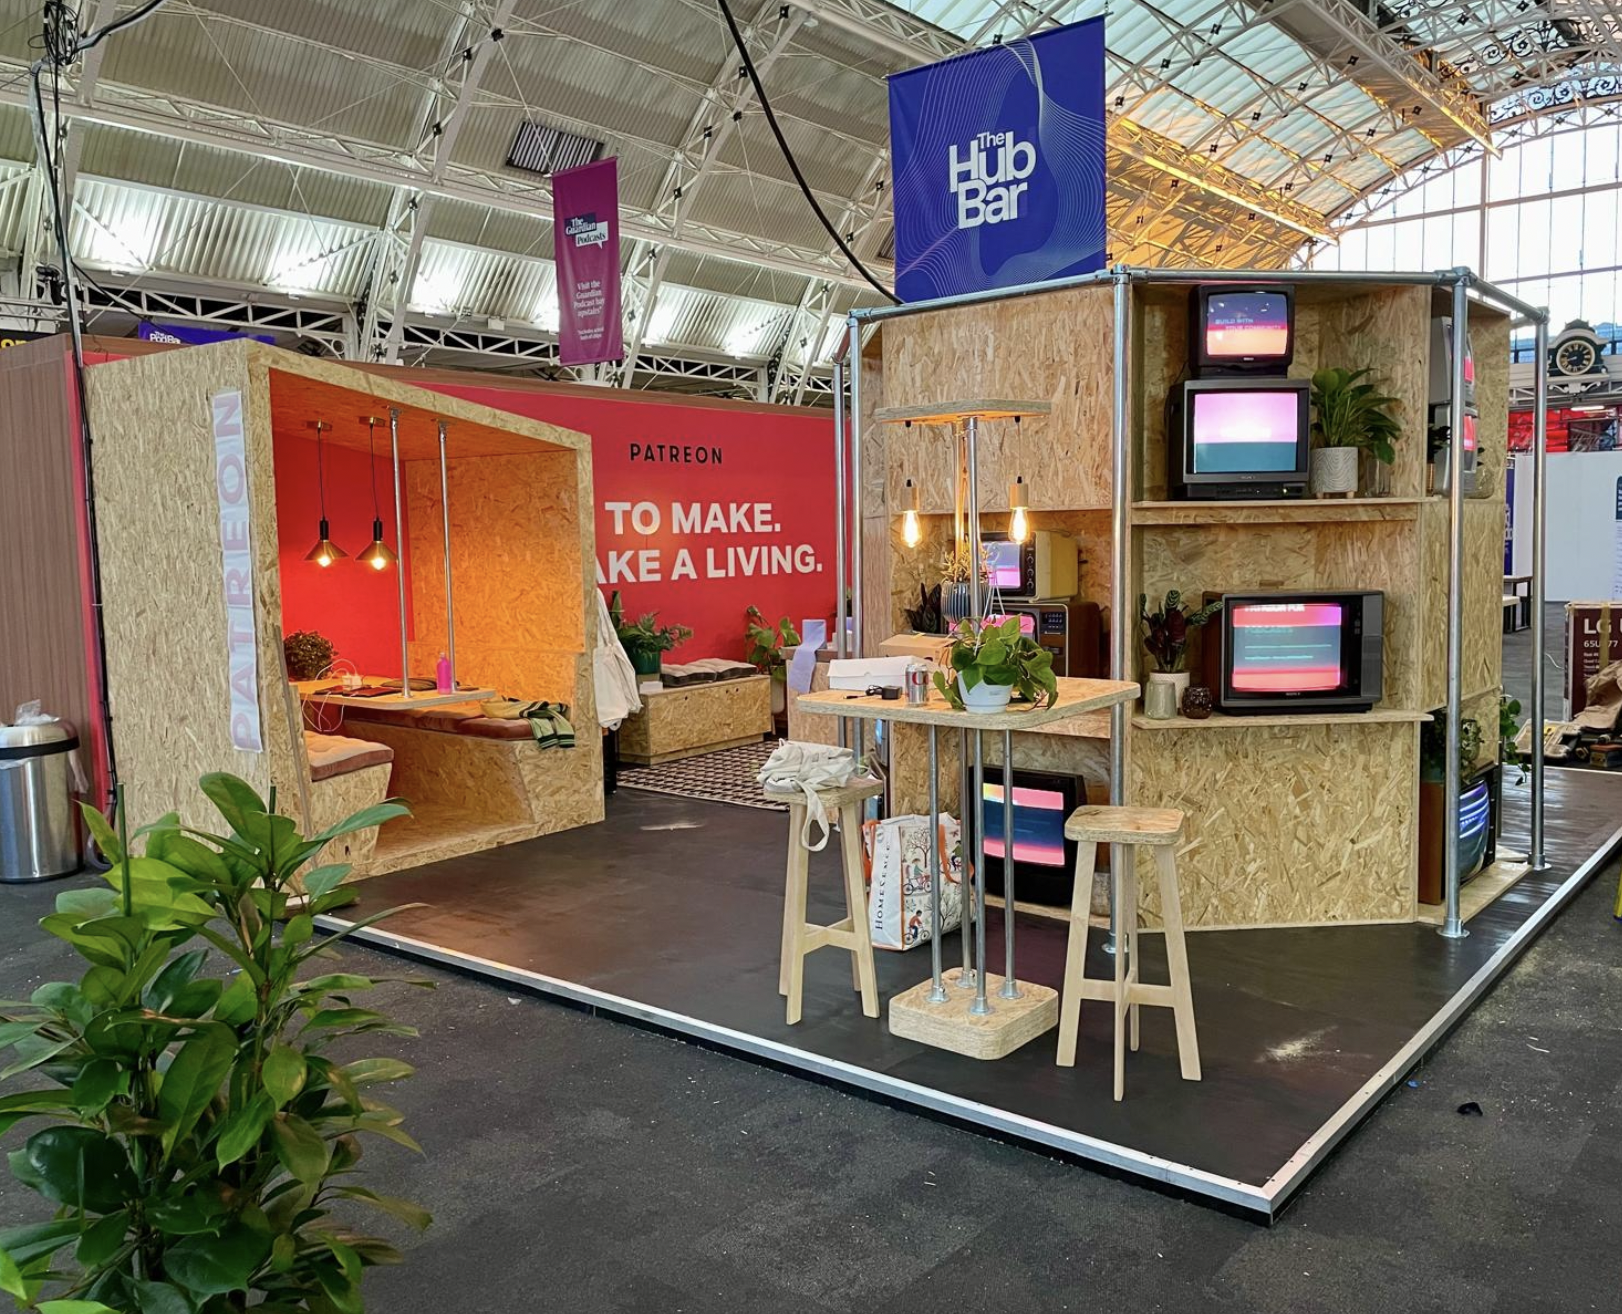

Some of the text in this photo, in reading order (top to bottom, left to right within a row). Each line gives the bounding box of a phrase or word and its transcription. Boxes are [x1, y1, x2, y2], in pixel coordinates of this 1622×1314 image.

[977, 131, 1005, 149] The
[949, 131, 1036, 193] Hub
[958, 179, 1028, 229] Bar
[566, 222, 596, 235] Guardian
[572, 217, 583, 227] The
[577, 232, 606, 245] Podcasts
[630, 443, 723, 464] PATREON
[605, 501, 781, 535] TO MAKE.
[213, 394, 260, 749] PATREON
[671, 549, 697, 581] A
[706, 544, 823, 578] LIVING.
[1583, 640, 1619, 648] 65U77
